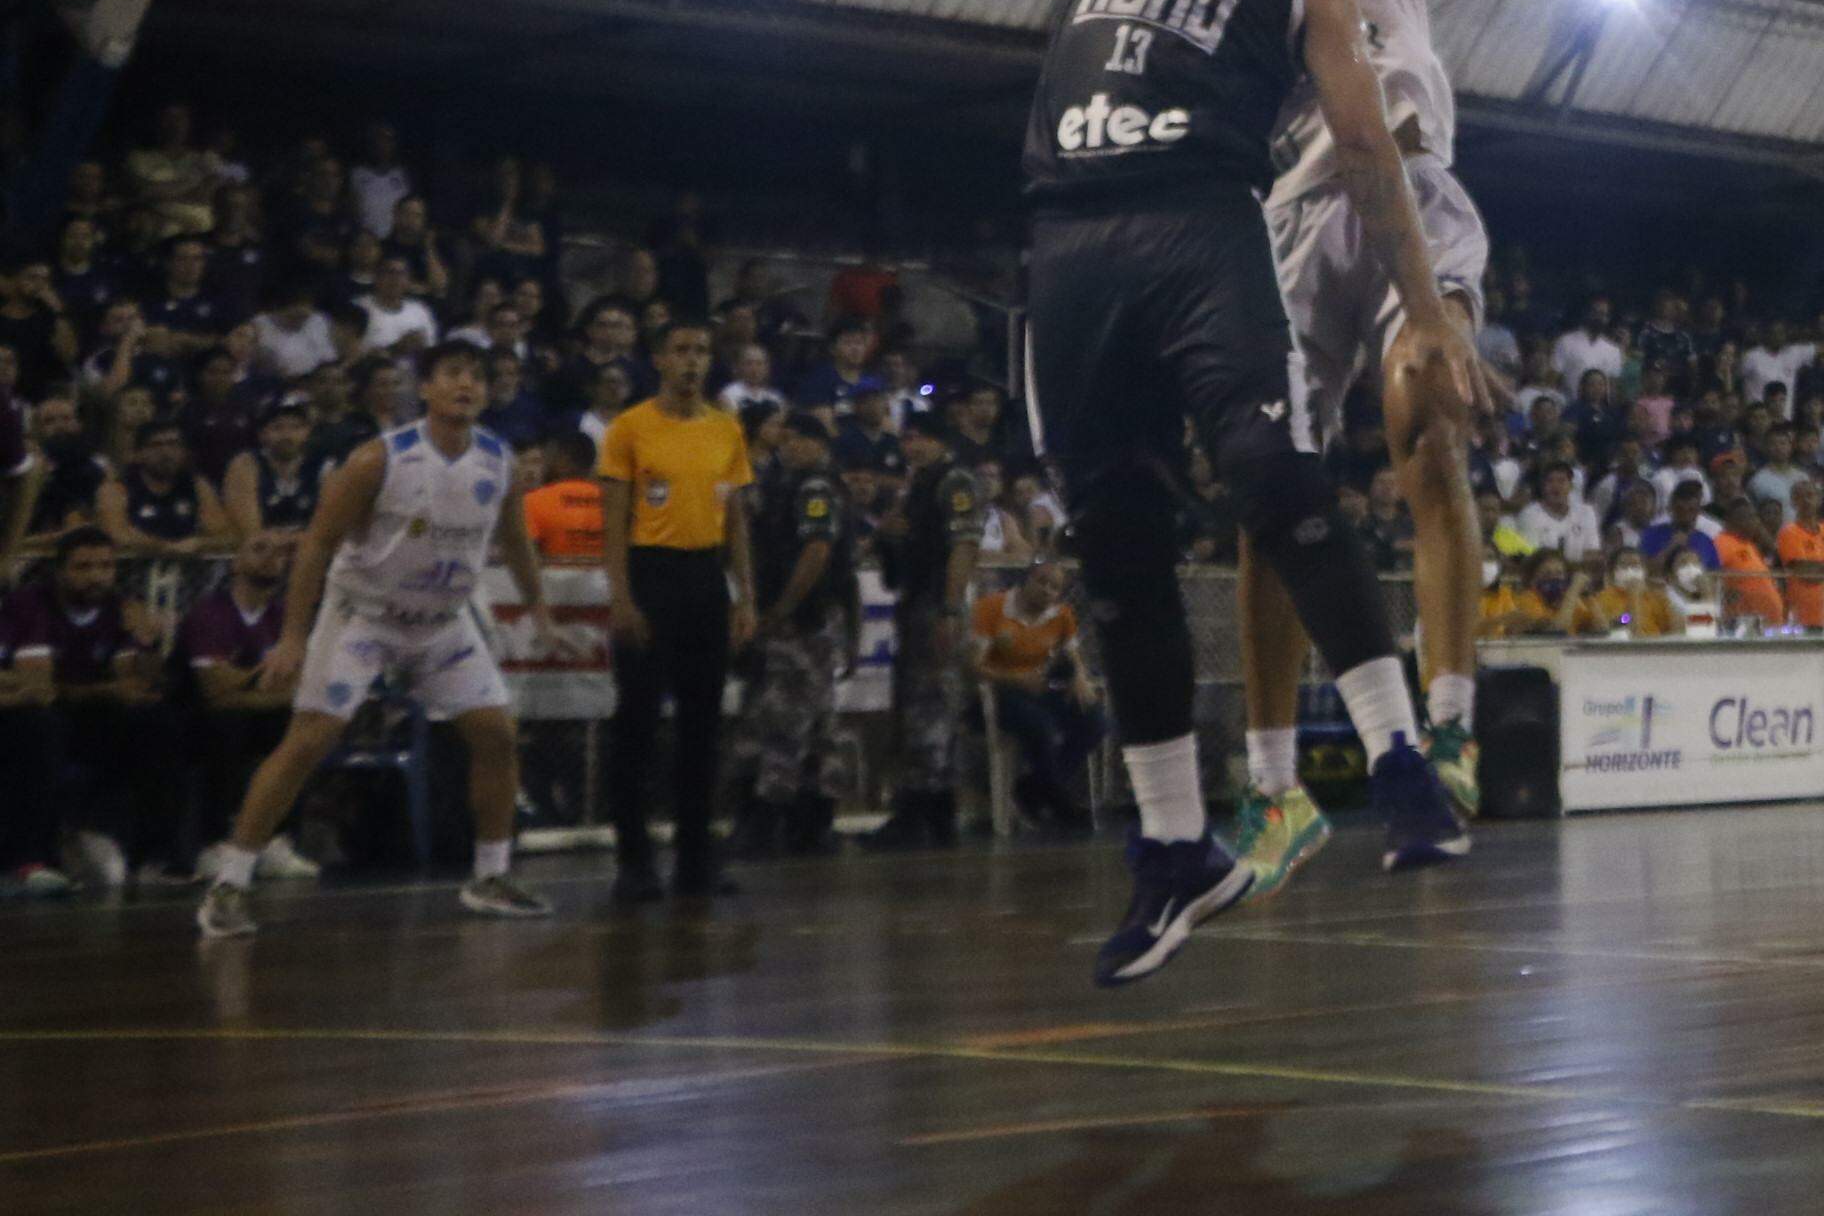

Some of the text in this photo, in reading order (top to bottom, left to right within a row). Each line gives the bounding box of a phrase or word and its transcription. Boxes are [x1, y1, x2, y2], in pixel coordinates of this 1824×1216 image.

[1105, 25, 1153, 74] 13
[1057, 93, 1191, 151] etec
[1709, 697, 1813, 750] Clean
[1585, 750, 1681, 773] HORIZONTE
